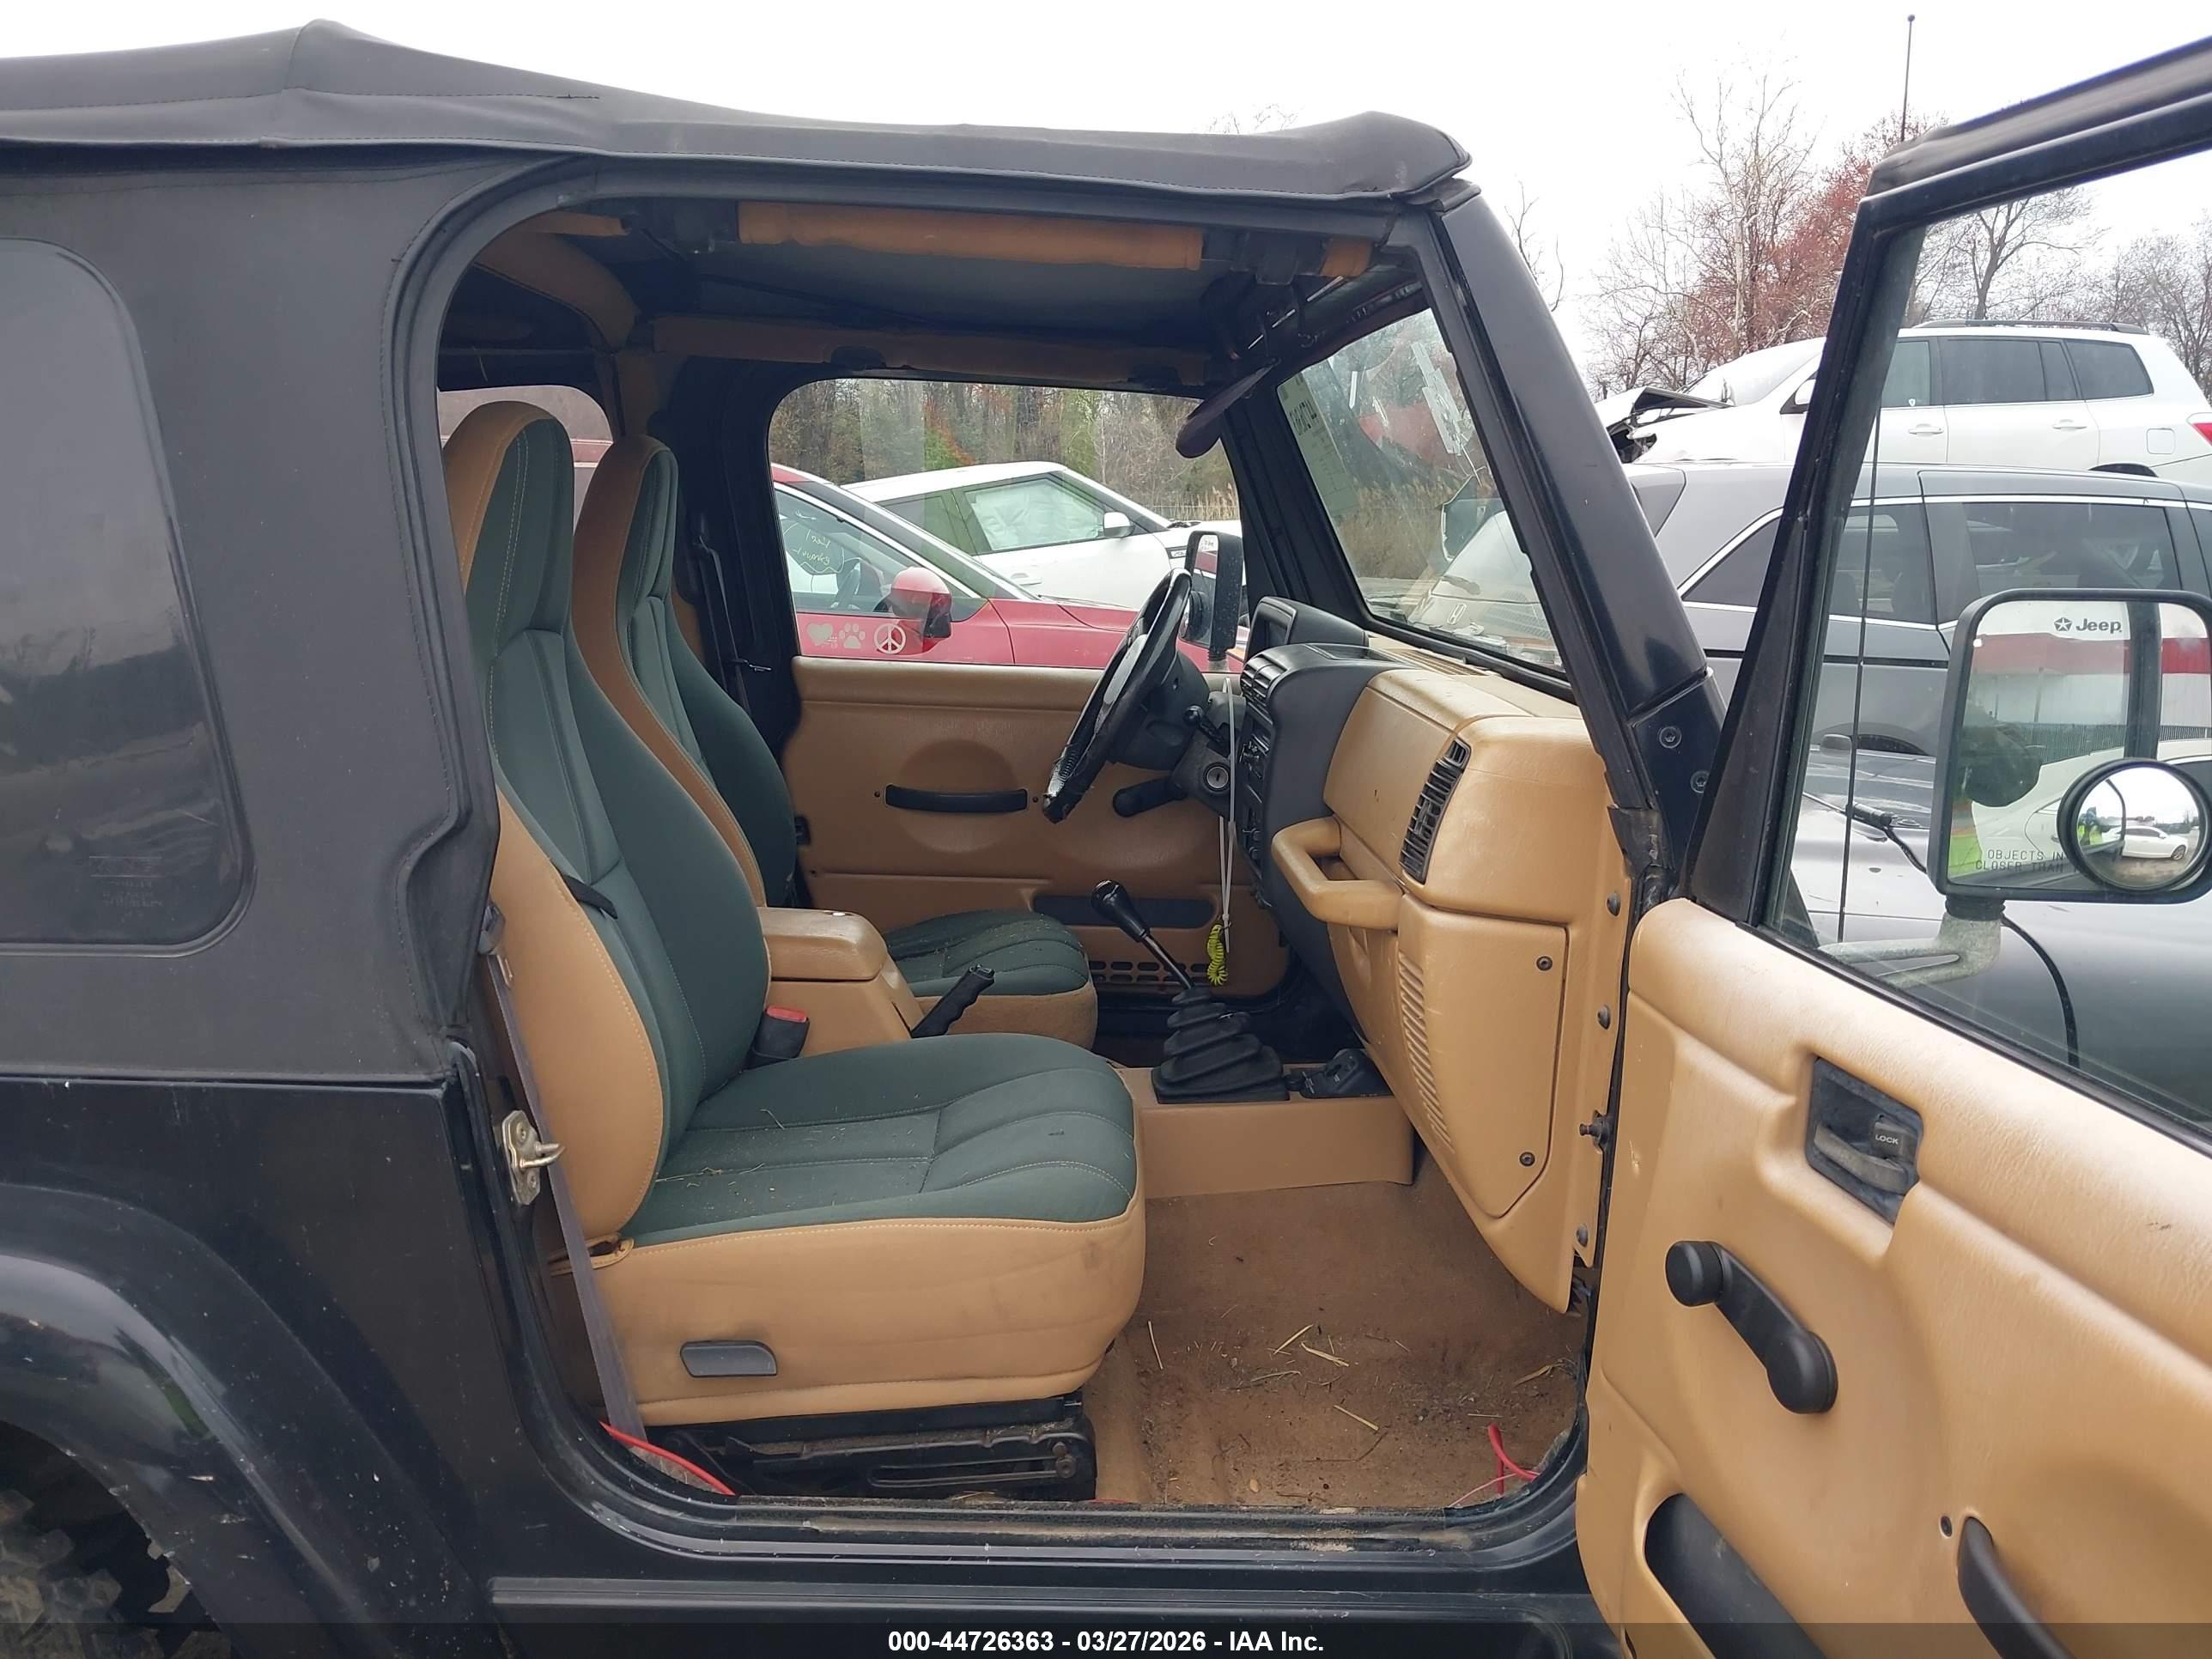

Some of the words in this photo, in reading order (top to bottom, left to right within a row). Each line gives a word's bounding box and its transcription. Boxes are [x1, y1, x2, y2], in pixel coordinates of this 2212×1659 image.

[1988, 849, 2044, 860] OBJECTS
[2052, 851, 2064, 860] IN
[1975, 860, 2022, 871] CLOSER
[1875, 1133, 1899, 1145] LOCK
